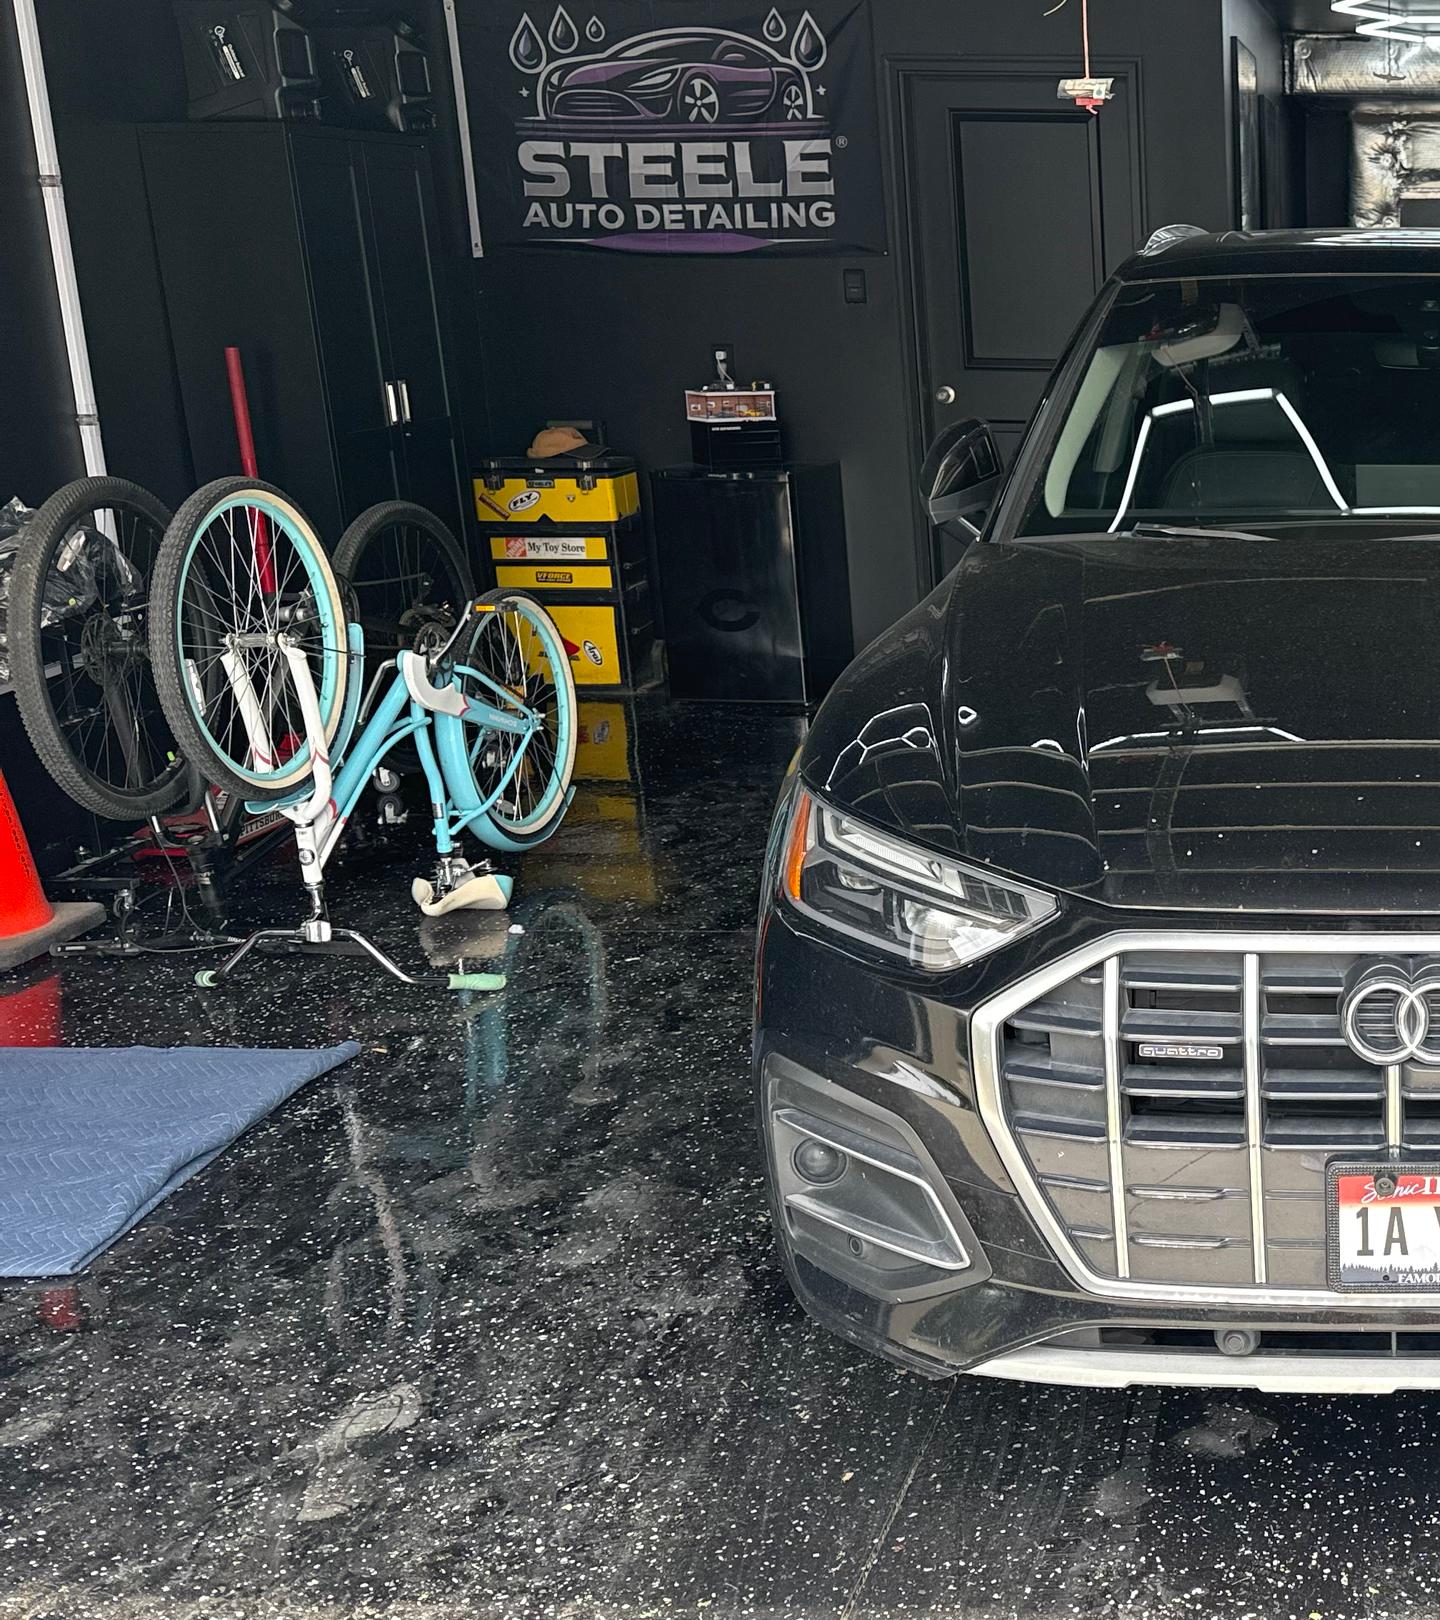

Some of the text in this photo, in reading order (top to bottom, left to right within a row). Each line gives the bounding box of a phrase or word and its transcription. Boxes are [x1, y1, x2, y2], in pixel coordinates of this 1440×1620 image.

[518, 139, 836, 198] STEELE
[523, 201, 836, 230] AUTO DETAILING
[512, 493, 534, 508] FLY
[527, 542, 541, 553] My
[542, 542, 560, 553] Toy
[561, 541, 585, 553] Store
[1142, 1046, 1219, 1057] quattro
[1356, 1206, 1409, 1257] 1A
